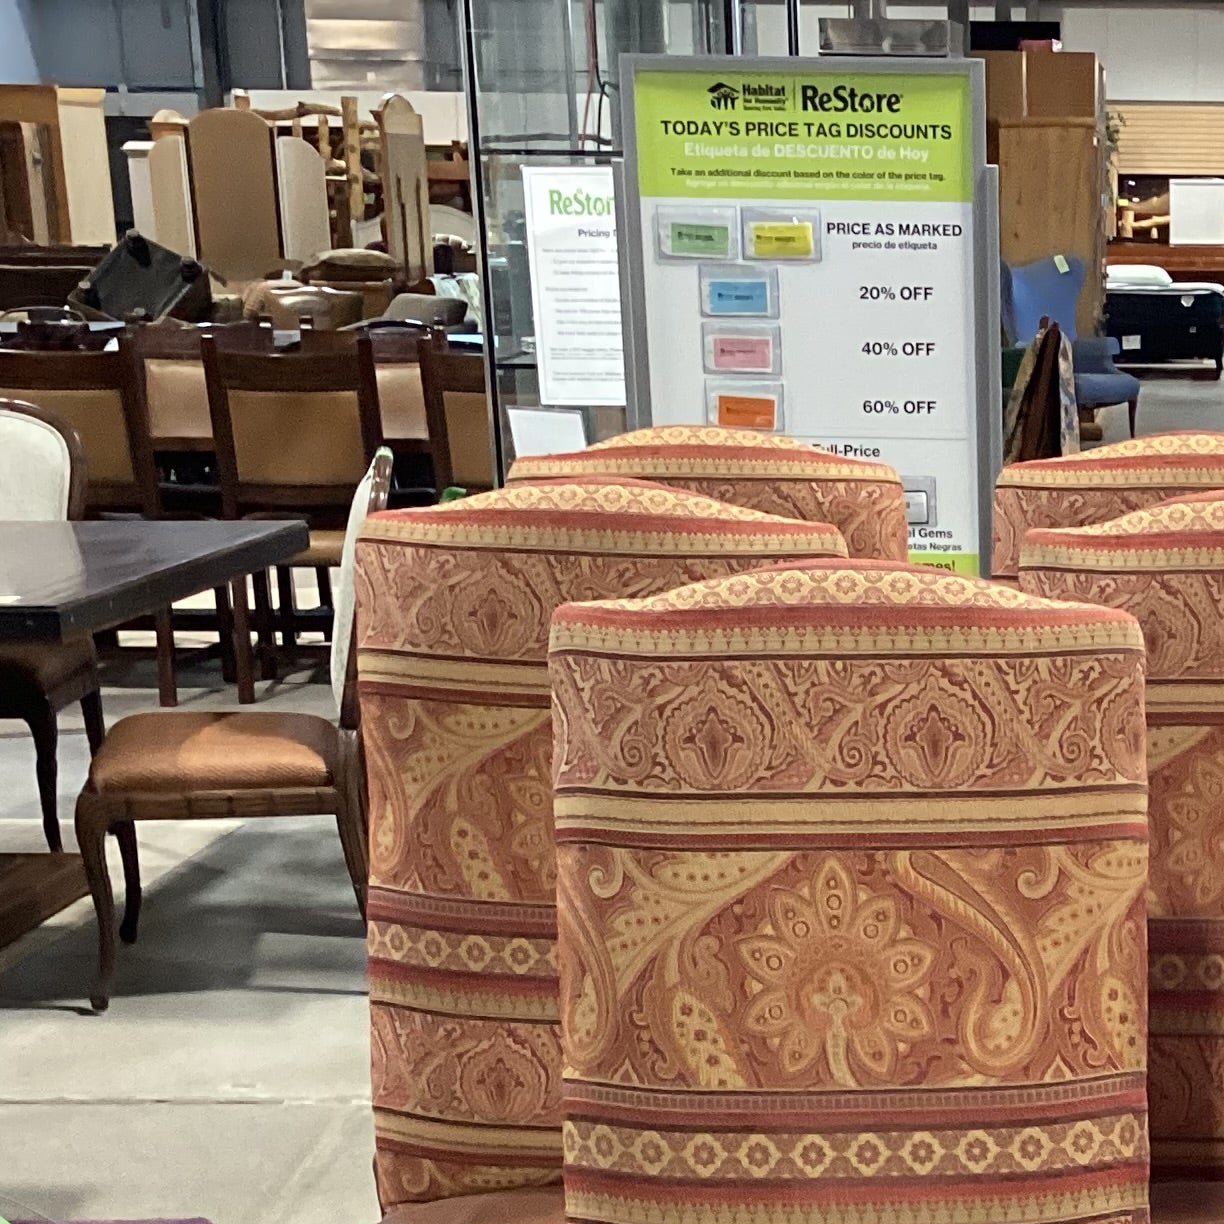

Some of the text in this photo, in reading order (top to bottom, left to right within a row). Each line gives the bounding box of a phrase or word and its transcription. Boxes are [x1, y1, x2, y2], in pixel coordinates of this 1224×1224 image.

[742, 83, 786, 97] Habitat
[801, 84, 901, 113] ReStore
[660, 120, 952, 140] TODAY'S PRICE TAG DISCOUNTS
[684, 142, 929, 163] Etiqueta de DESCUENTO de Hoy
[670, 167, 693, 177] Take
[708, 168, 752, 178] additional
[753, 169, 792, 178] discount
[794, 170, 821, 179] based
[835, 170, 850, 180] the
[852, 171, 875, 180] color
[888, 171, 903, 181] the
[904, 172, 928, 183] price
[548, 189, 614, 217] ReStor
[577, 229, 610, 239] Pricing
[826, 222, 963, 237] PRICE AS MARKED
[852, 240, 938, 251] precio de etiqueta
[859, 286, 934, 301] 20% OFF
[861, 342, 936, 356] 40% OFF
[863, 400, 937, 415] 60% OFF
[918, 528, 953, 539] Gems
[929, 541, 962, 551] Negras
